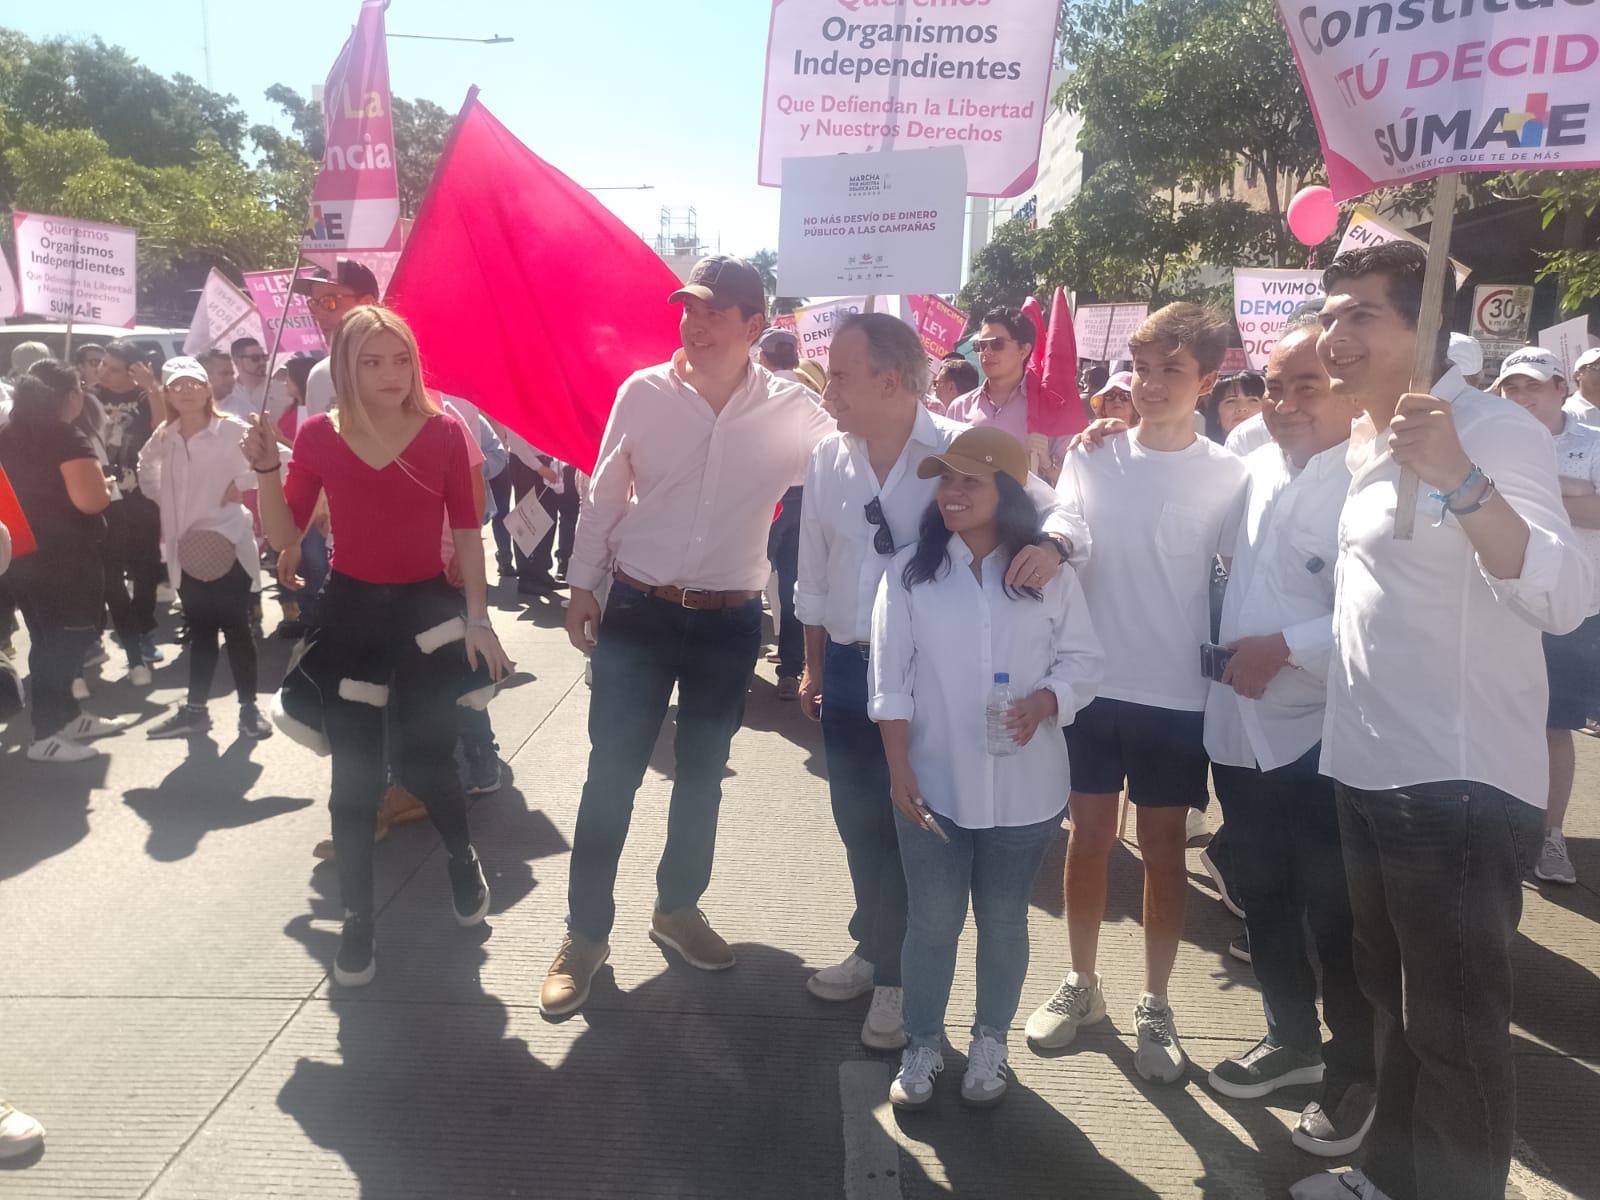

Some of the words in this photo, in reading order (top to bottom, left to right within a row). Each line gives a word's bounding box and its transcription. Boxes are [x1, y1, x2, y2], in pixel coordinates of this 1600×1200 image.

[822, 16, 998, 49] Organismos
[794, 49, 1022, 83] Independientes
[343, 81, 385, 119] La
[777, 94, 815, 116] Que
[821, 95, 918, 115] Defiendan
[924, 97, 941, 116] la
[947, 98, 1034, 119] Libertad
[800, 122, 810, 142] y
[816, 118, 900, 137] Nuestros
[906, 120, 1003, 142] Derechos
[324, 132, 392, 173] ncia
[1460, 154, 1485, 162] QUE
[1491, 153, 1505, 161] TE
[1511, 152, 1527, 161] DE
[1533, 151, 1560, 161] MÁS
[849, 174, 880, 182] MARCHA
[803, 217, 818, 226] NO
[820, 213, 841, 224] MÁS
[844, 211, 880, 223] DESVÍO
[883, 212, 896, 221] DE
[899, 210, 938, 220] DINERO
[804, 226, 846, 237] PÚBLICO
[848, 227, 855, 235] A
[857, 225, 876, 234] LAS
[879, 221, 936, 233] CAMPAÑAS
[42, 221, 110, 242] Queremos
[1349, 224, 1373, 244] EN
[40, 236, 114, 259] Organismos
[31, 250, 125, 276] Independientes
[1489, 298, 1516, 319] 30
[922, 317, 947, 342] LEY.
[1239, 321, 1256, 332] NO
